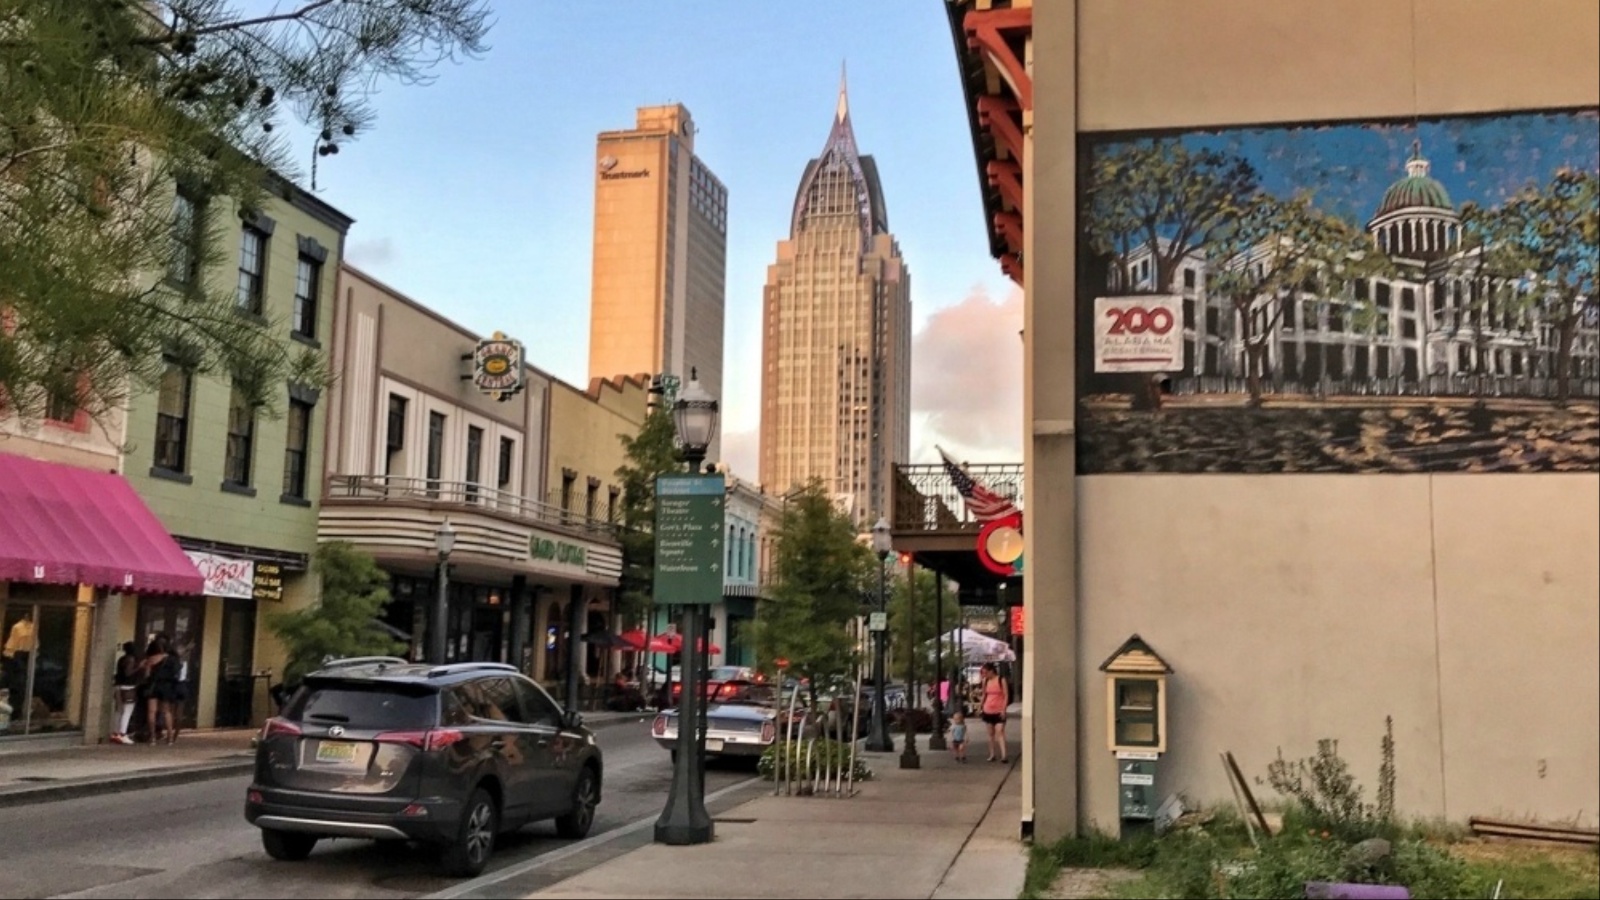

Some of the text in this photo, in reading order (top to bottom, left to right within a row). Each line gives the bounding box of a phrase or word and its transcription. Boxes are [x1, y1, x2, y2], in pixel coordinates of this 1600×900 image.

[599, 169, 650, 181] Trustmark
[1105, 306, 1174, 335] 200
[1103, 337, 1172, 346] ALABAMA
[683, 523, 702, 531] Plaza
